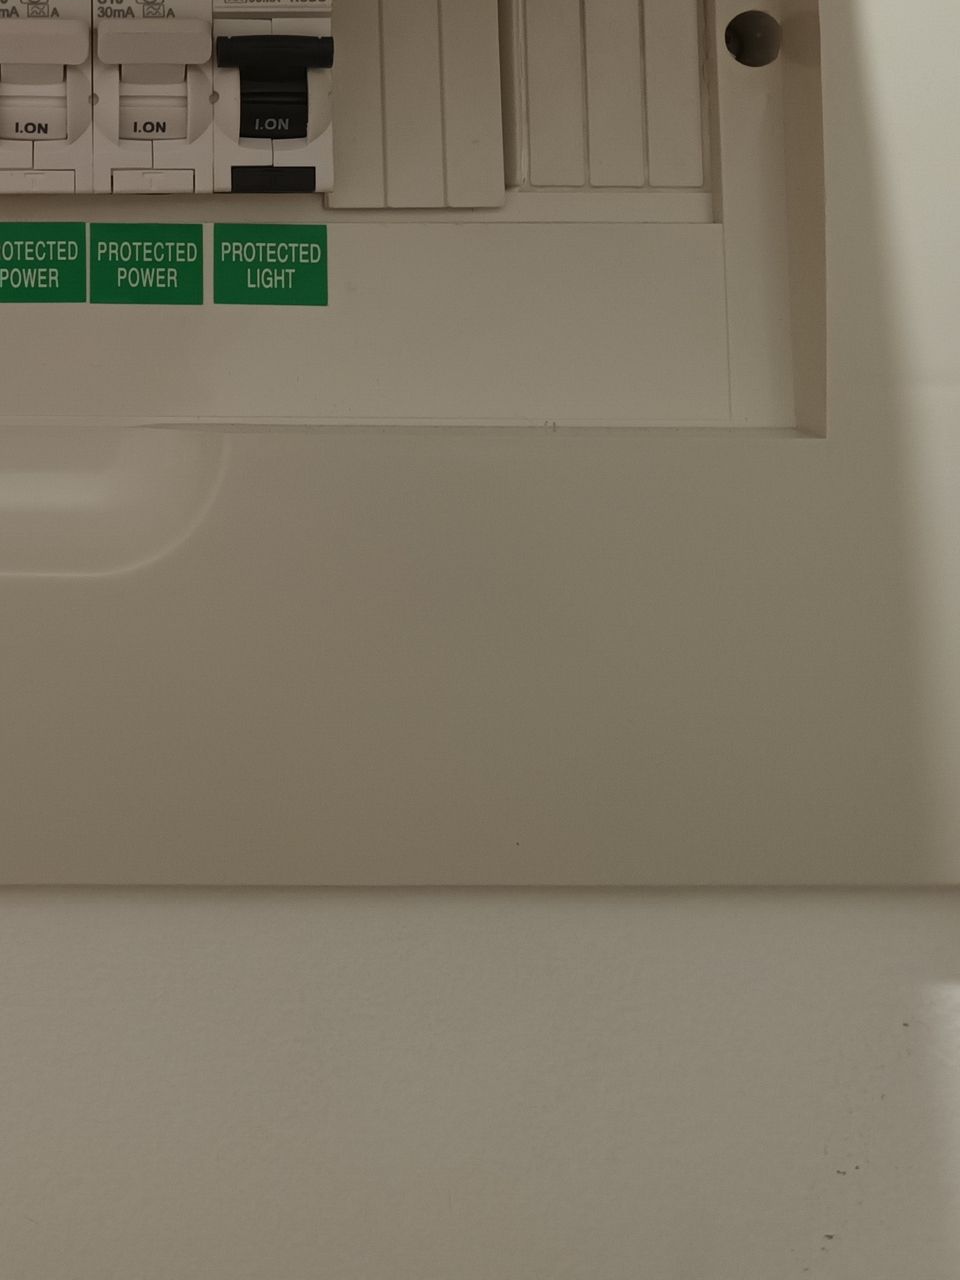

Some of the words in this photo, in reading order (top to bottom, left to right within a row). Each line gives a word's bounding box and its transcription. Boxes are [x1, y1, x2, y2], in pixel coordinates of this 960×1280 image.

[97, 6, 135, 18] 30mA
[97, 242, 198, 262] PROTECTED
[221, 242, 321, 264] PROTECTED
[0, 268, 59, 288] POWER
[117, 268, 178, 288] POWER
[247, 268, 295, 289] LIGHT
